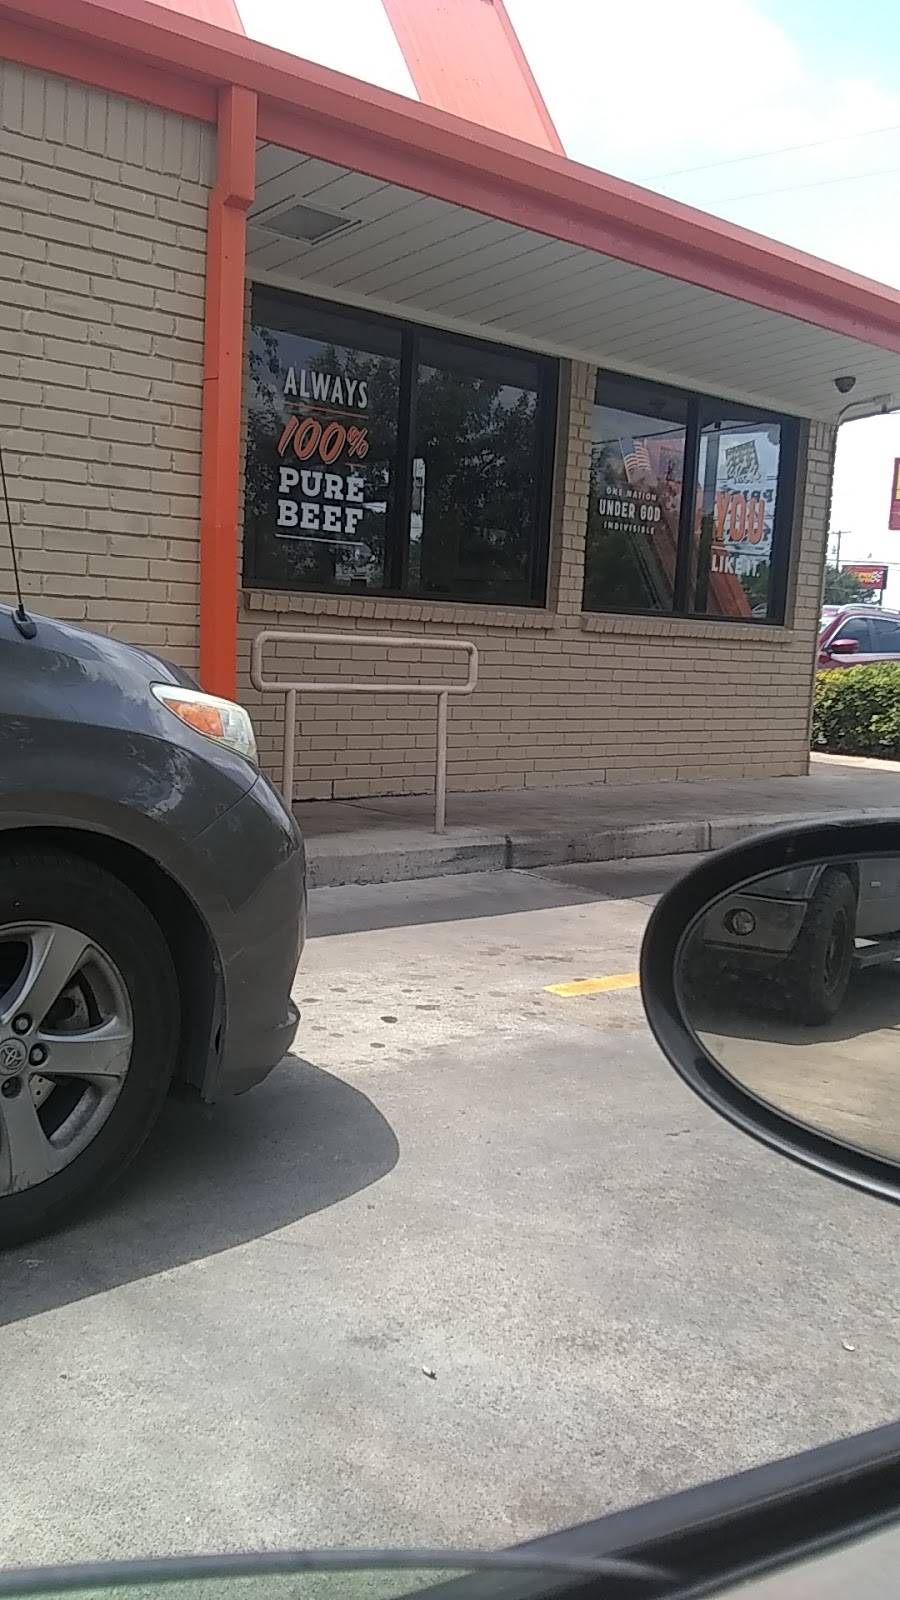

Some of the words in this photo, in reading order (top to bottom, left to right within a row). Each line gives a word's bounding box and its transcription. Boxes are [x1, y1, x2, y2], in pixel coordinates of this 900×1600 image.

[283, 366, 369, 409] ALWAYS
[277, 415, 370, 465] 100%
[278, 466, 365, 503] PURE
[606, 486, 622, 496] ONE
[626, 489, 657, 501] NATION
[277, 499, 364, 535] BEEF
[599, 498, 636, 519] UNDER
[640, 504, 661, 522] GOD
[603, 520, 655, 535] INDIVISIBLE
[713, 490, 765, 545] YOU
